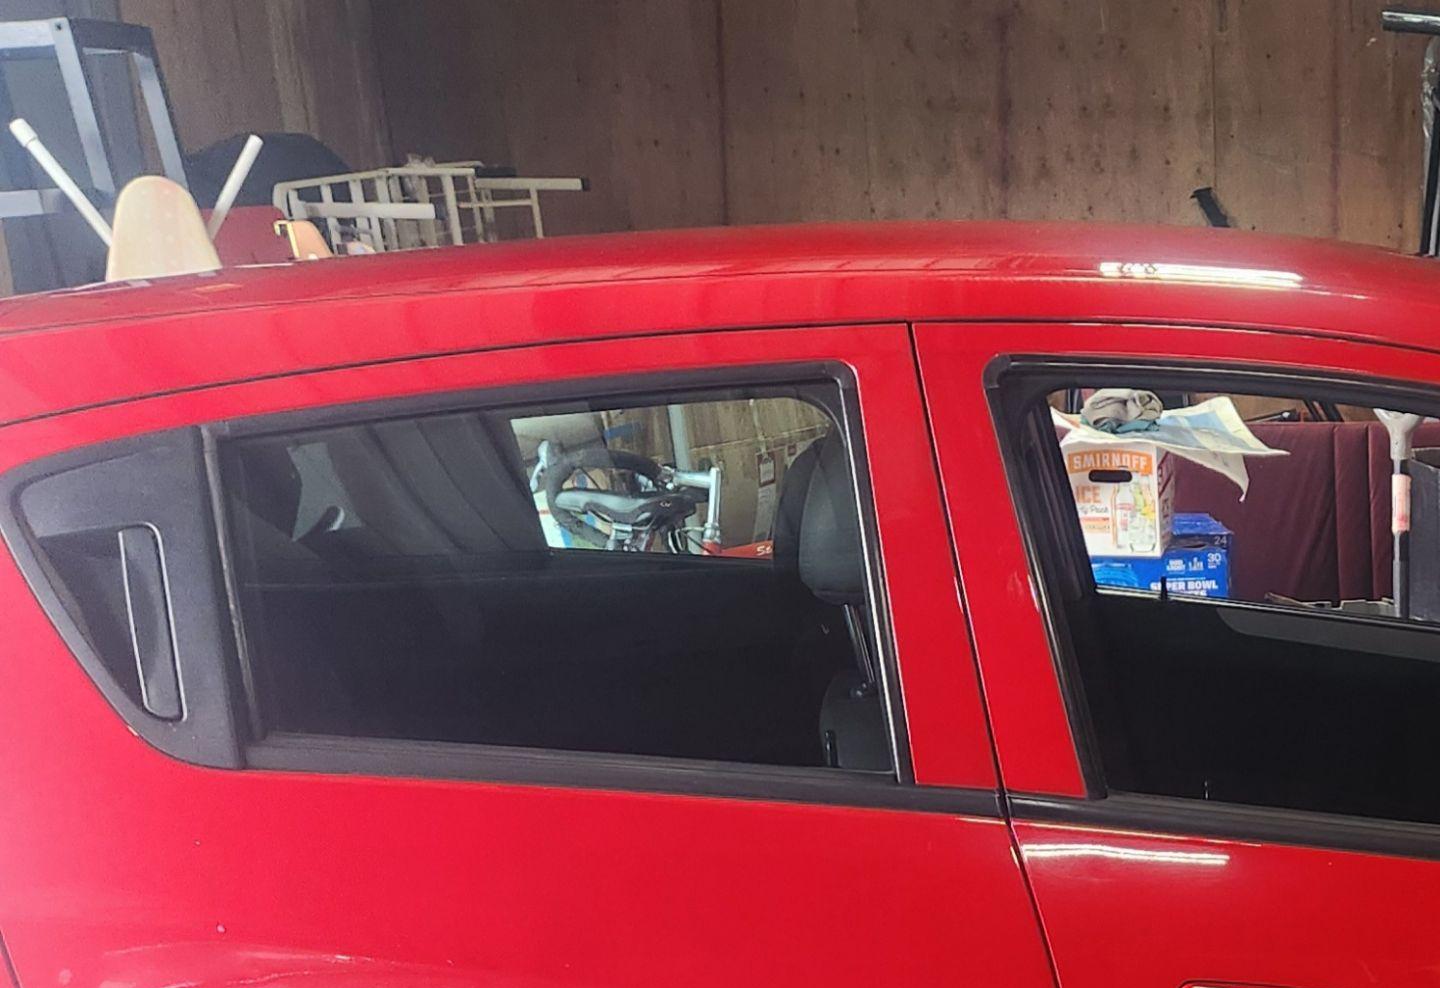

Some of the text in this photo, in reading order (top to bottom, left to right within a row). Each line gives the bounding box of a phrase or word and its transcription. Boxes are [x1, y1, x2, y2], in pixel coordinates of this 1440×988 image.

[1073, 453, 1147, 470] SMIRNOFF
[1076, 485, 1101, 503] ICE
[1214, 535, 1227, 545] 24
[1207, 552, 1221, 562] 30
[1187, 580, 1218, 590] BOWL
